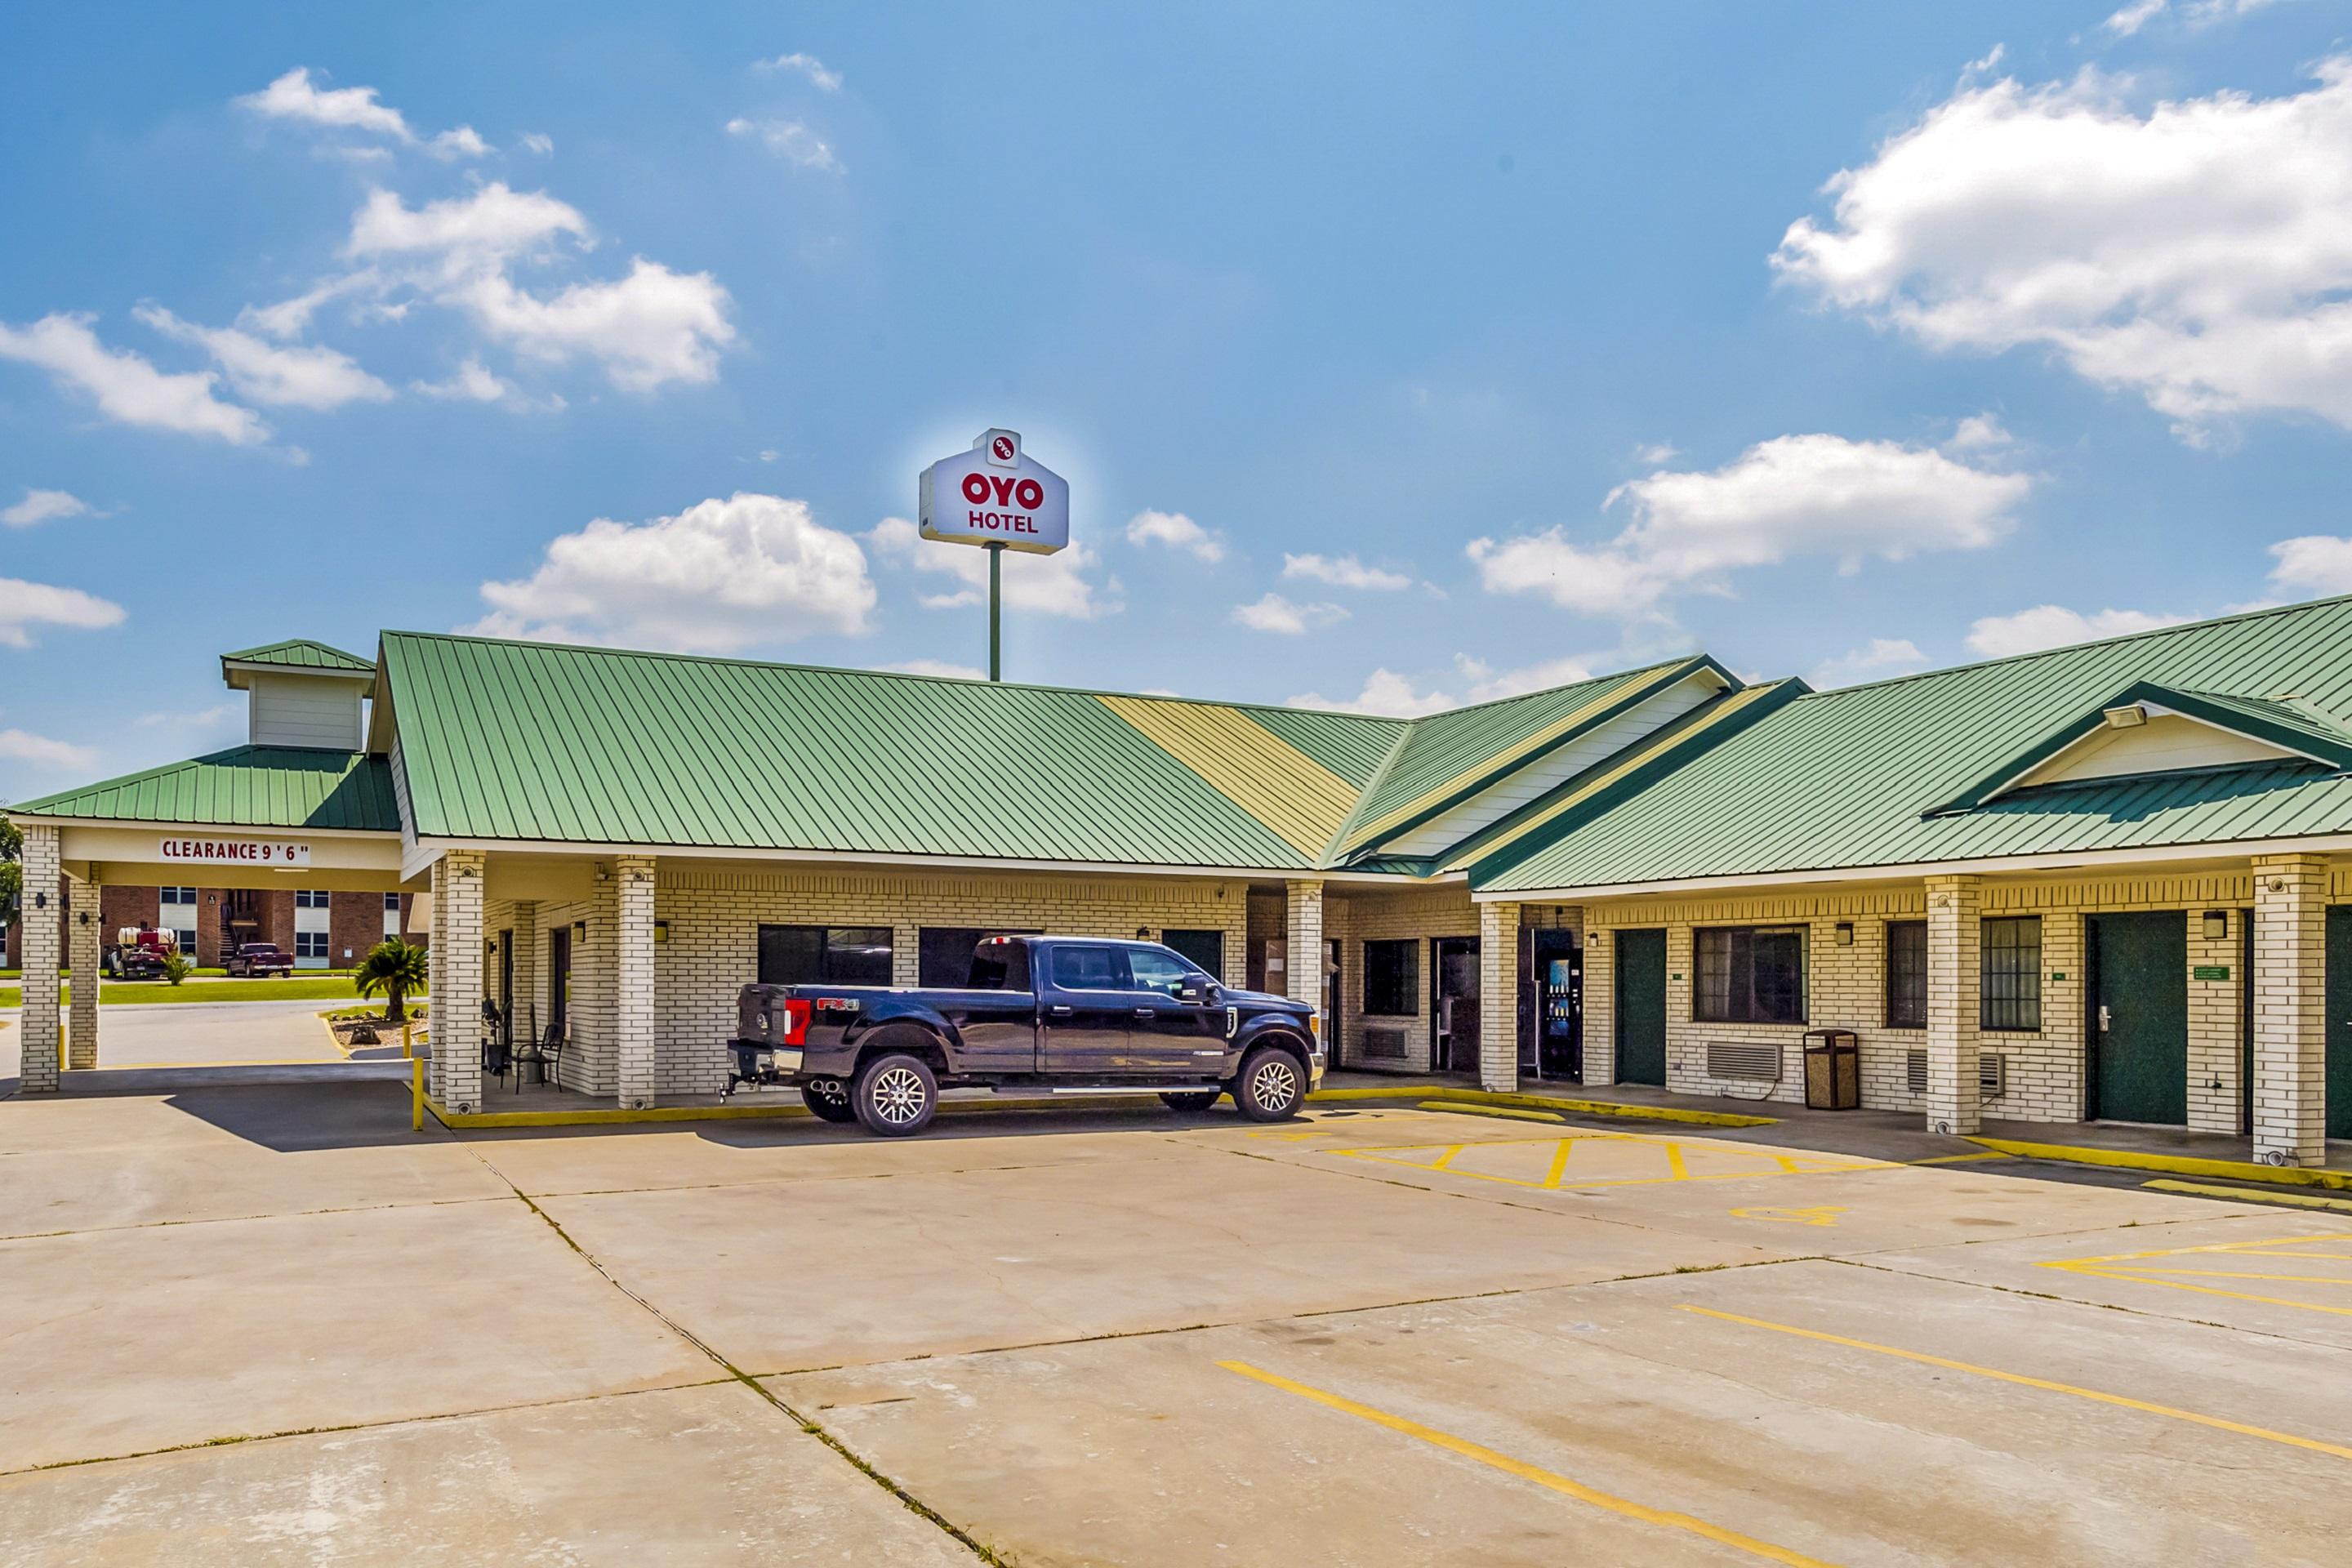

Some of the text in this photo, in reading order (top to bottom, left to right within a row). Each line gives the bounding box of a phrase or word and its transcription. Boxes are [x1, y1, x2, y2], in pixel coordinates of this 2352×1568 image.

[996, 439, 1012, 458] OYO
[961, 472, 1044, 510] OYO
[969, 510, 1039, 533] HOTEL
[163, 840, 257, 859] CLEARANCE
[817, 997, 860, 1011] FX4
